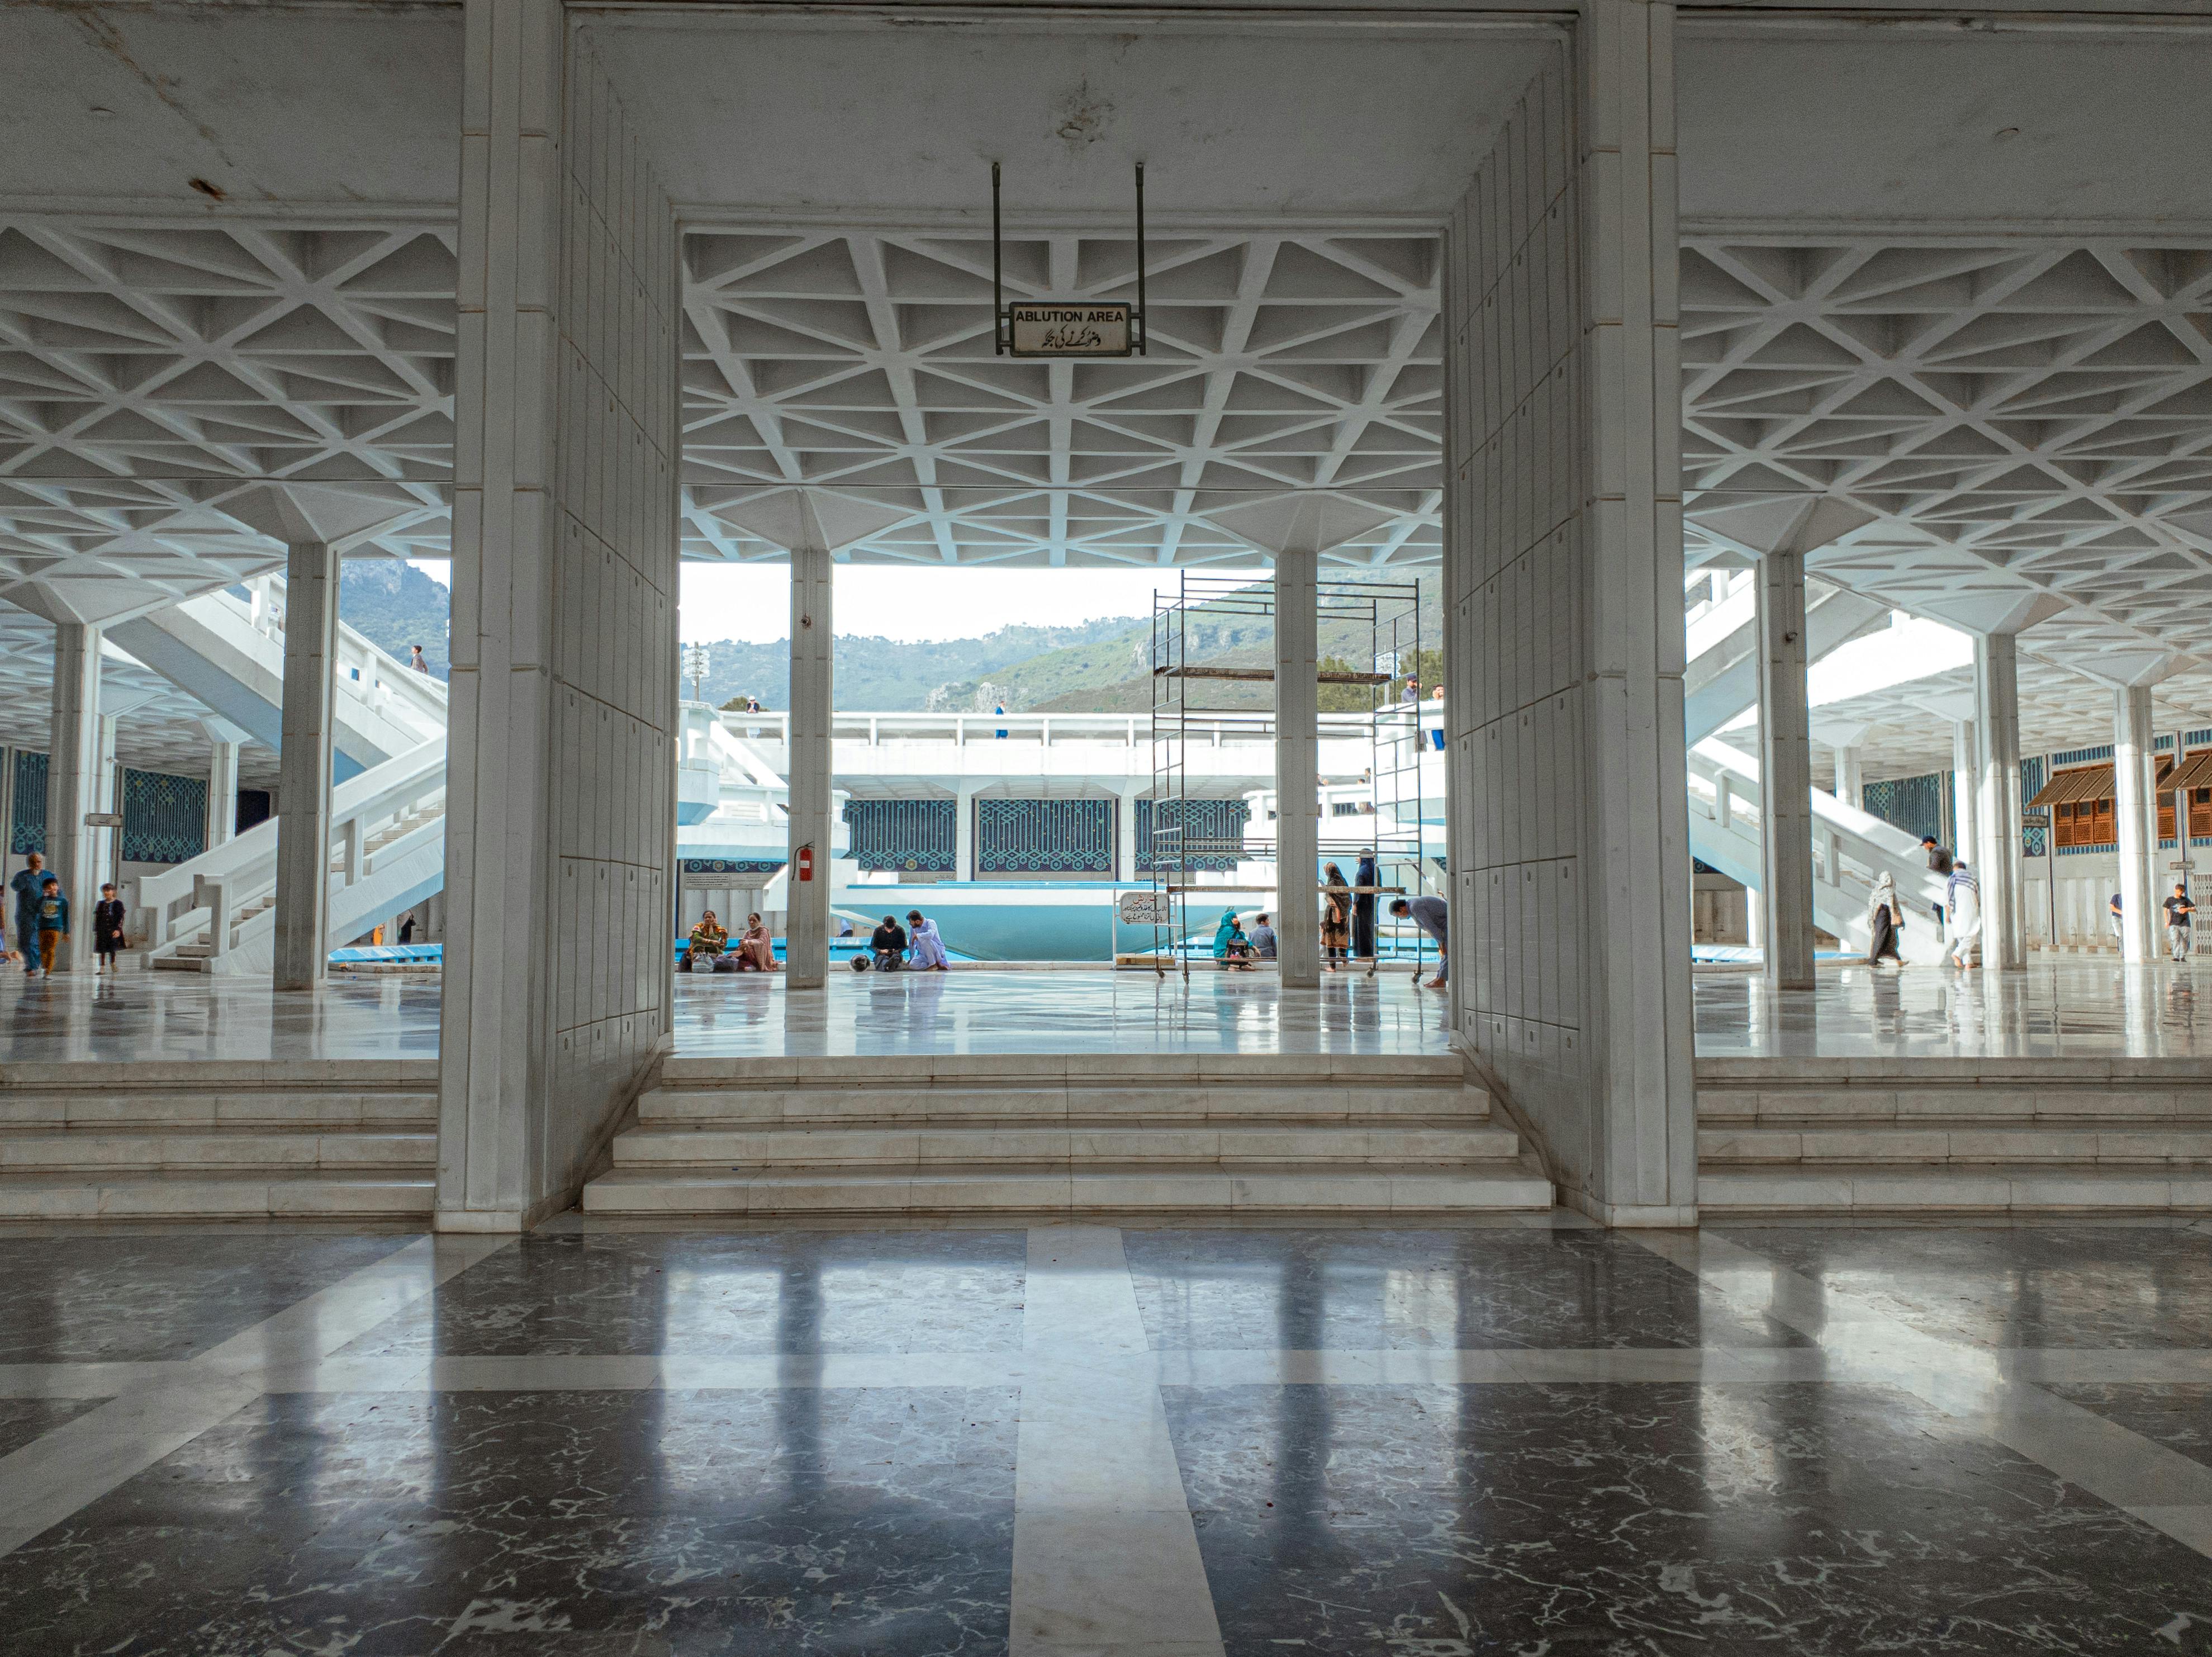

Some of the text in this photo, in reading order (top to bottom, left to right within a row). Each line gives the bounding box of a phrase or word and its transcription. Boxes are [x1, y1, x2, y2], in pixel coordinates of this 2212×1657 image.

[1016, 311, 1124, 322] ABLUTION AREA
[1042, 329, 1055, 348] جگہ
[1055, 324, 1068, 349] کی
[1133, 894, 1157, 905] زارش
